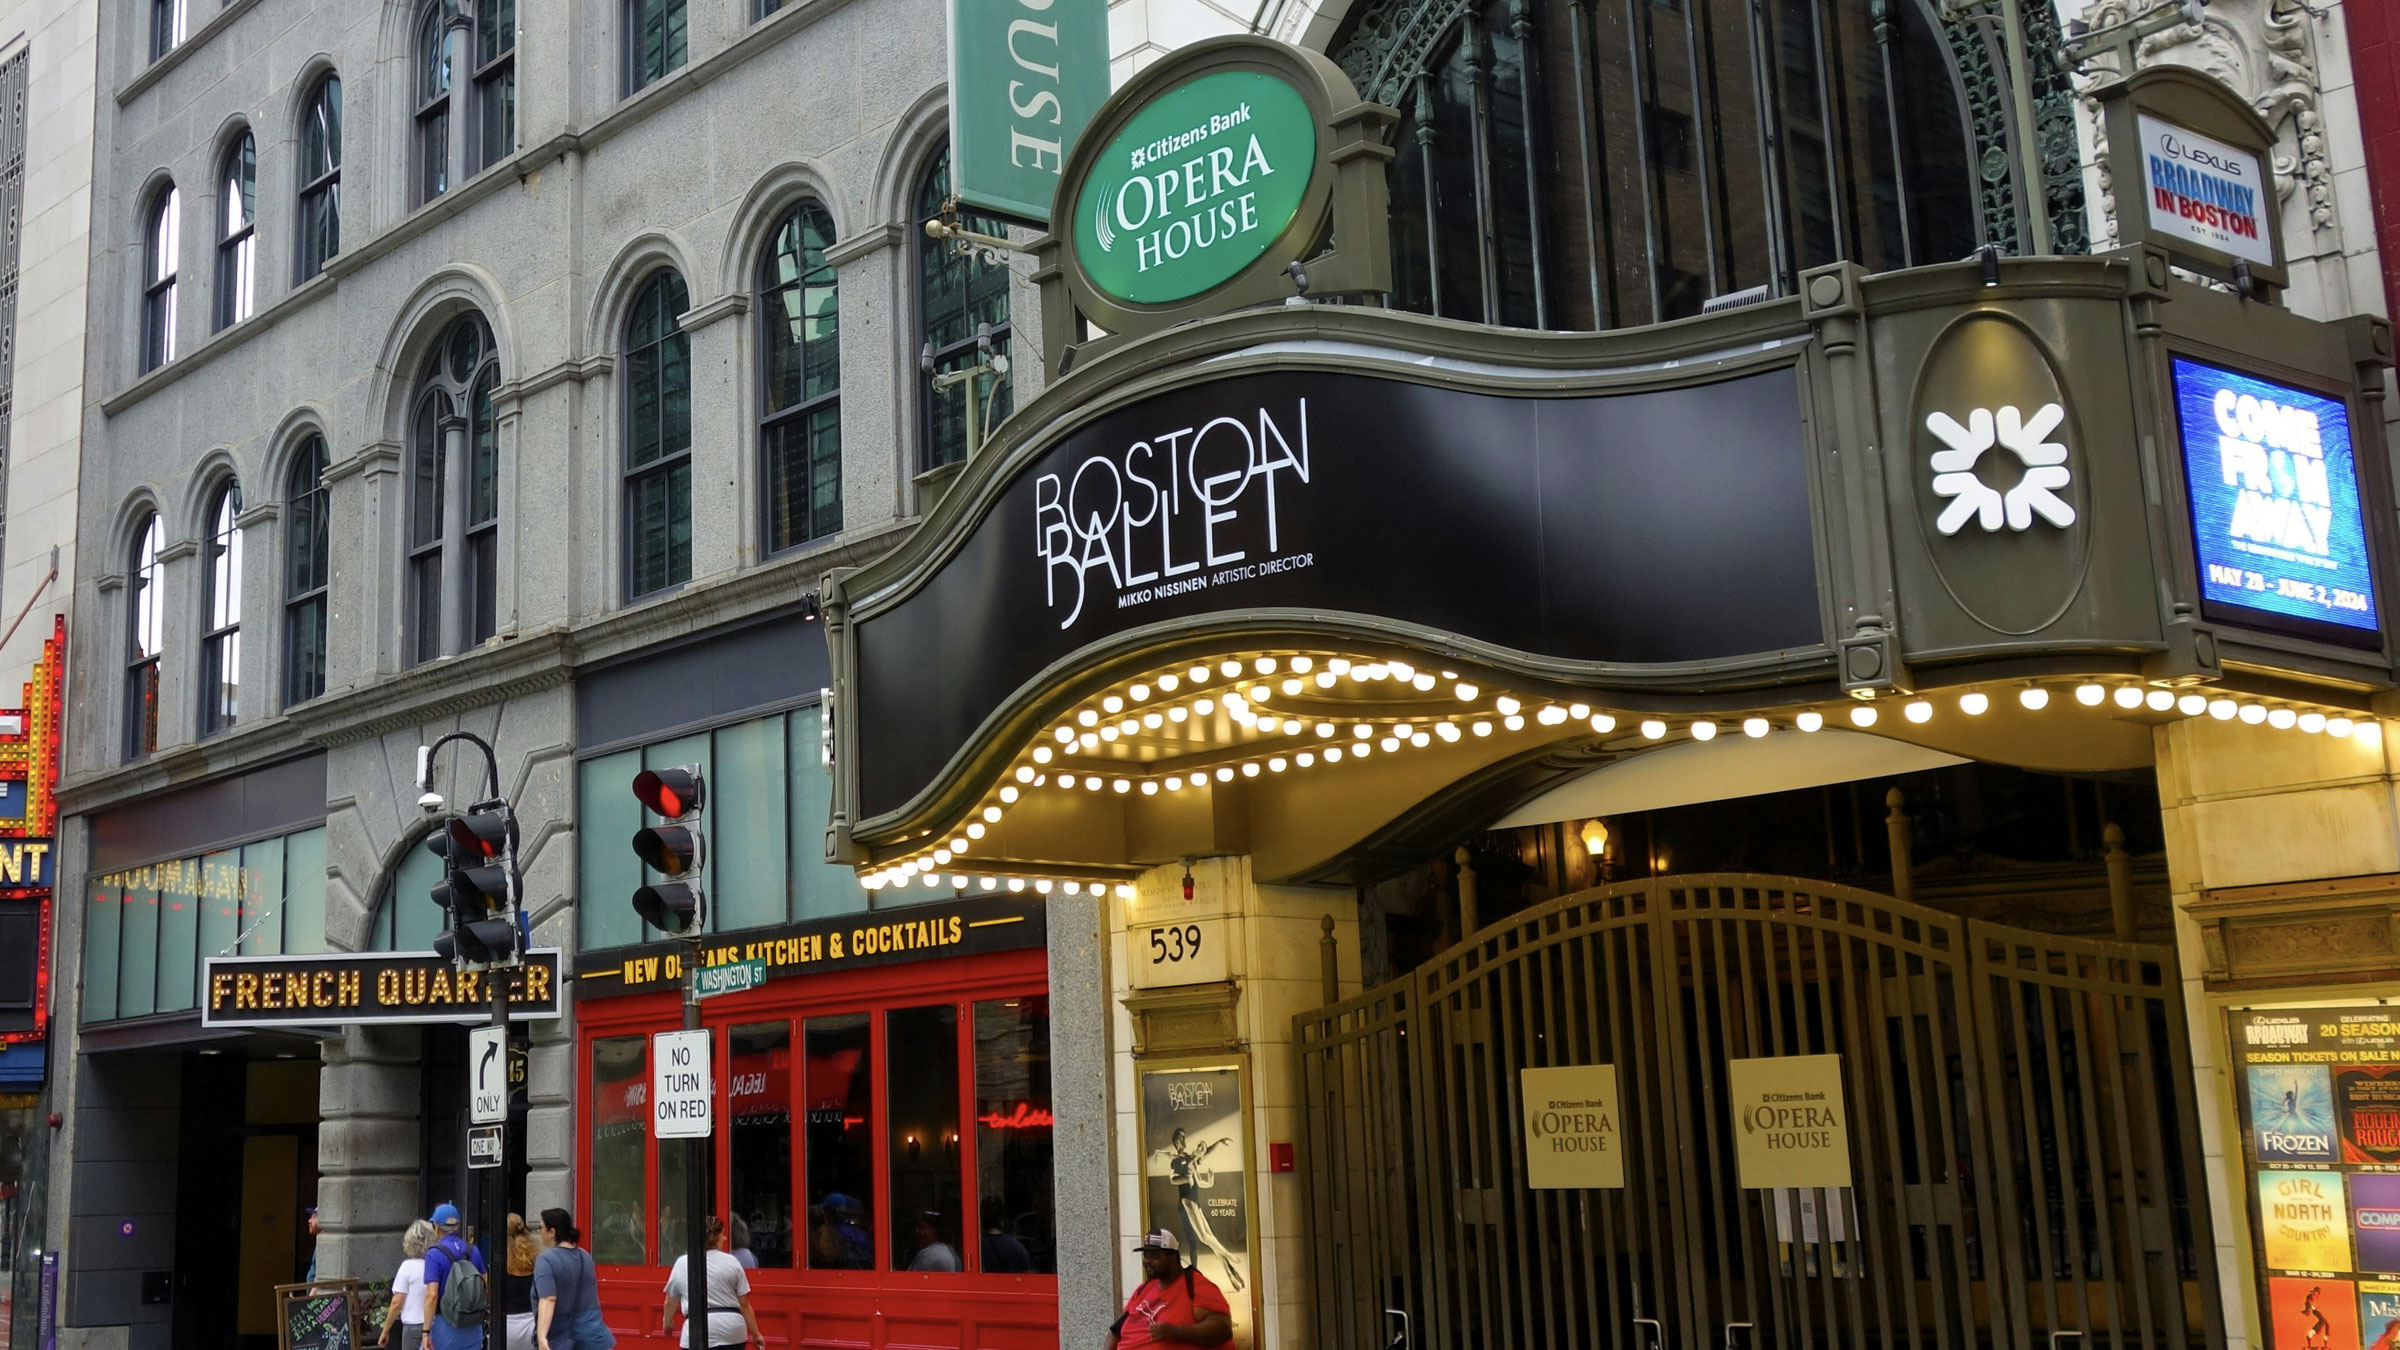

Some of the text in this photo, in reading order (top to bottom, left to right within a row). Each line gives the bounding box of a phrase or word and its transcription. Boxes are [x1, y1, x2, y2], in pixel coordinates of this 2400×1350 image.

[1007, 0, 1063, 175] USE
[1146, 102, 1252, 163] Citizens Bank
[2181, 144, 2242, 176] LEXUS
[1116, 133, 1275, 231] OPERA
[2150, 154, 2255, 217] BROADWAY
[2154, 186, 2259, 240] IN BOSTON
[1137, 192, 1259, 273] HOUSE
[2213, 388, 2323, 459] COME
[1036, 397, 1310, 556] BOSTON
[2229, 488, 2332, 556] AWAY
[1046, 458, 1293, 630] BALLET
[1117, 552, 1314, 609] MIKKO NISSINEN ARTISTIC DIRECTOR
[2209, 563, 2243, 587] MAY
[2277, 578, 2314, 601] JUNE
[624, 916, 963, 985] NEW OANS KITCHEN & COCKTAILS
[1150, 925, 1202, 964] 539
[212, 965, 551, 1011] FRENCH QUARR
[701, 964, 763, 990] WASHINGTON ST
[2320, 1024, 2338, 1037] 20
[671, 1047, 690, 1067] NO
[2246, 1052, 2290, 1062] SEASON
[2292, 1052, 2338, 1062] TICKETS
[2340, 1051, 2358, 1061] ON
[2360, 1051, 2389, 1061] SALE
[664, 1073, 700, 1094] TURN
[1168, 1081, 1213, 1099] BOSTON
[476, 1094, 501, 1114] ONLY
[1170, 1090, 1211, 1111] BALLET
[1555, 1099, 1603, 1110] Citizens Bank
[1770, 1092, 1826, 1103] Citizens Bank
[658, 1100, 707, 1120] ON RED
[1754, 1105, 1838, 1129] OPERA
[1541, 1112, 1613, 1135] OPERA
[473, 1140, 485, 1154] ONE
[1552, 1136, 1607, 1153] HOUSE
[1767, 1131, 1831, 1149] HOUSE
[2262, 1131, 2329, 1155] FROZEN
[2356, 1129, 2400, 1147] ROUG
[2278, 1179, 2324, 1199] GIRL
[1208, 1198, 1238, 1207] CELEBRATE
[1211, 1208, 1236, 1217] 60 YEARS
[2273, 1203, 2332, 1221] NORTH
[2278, 1224, 2331, 1242] COUNTRY
